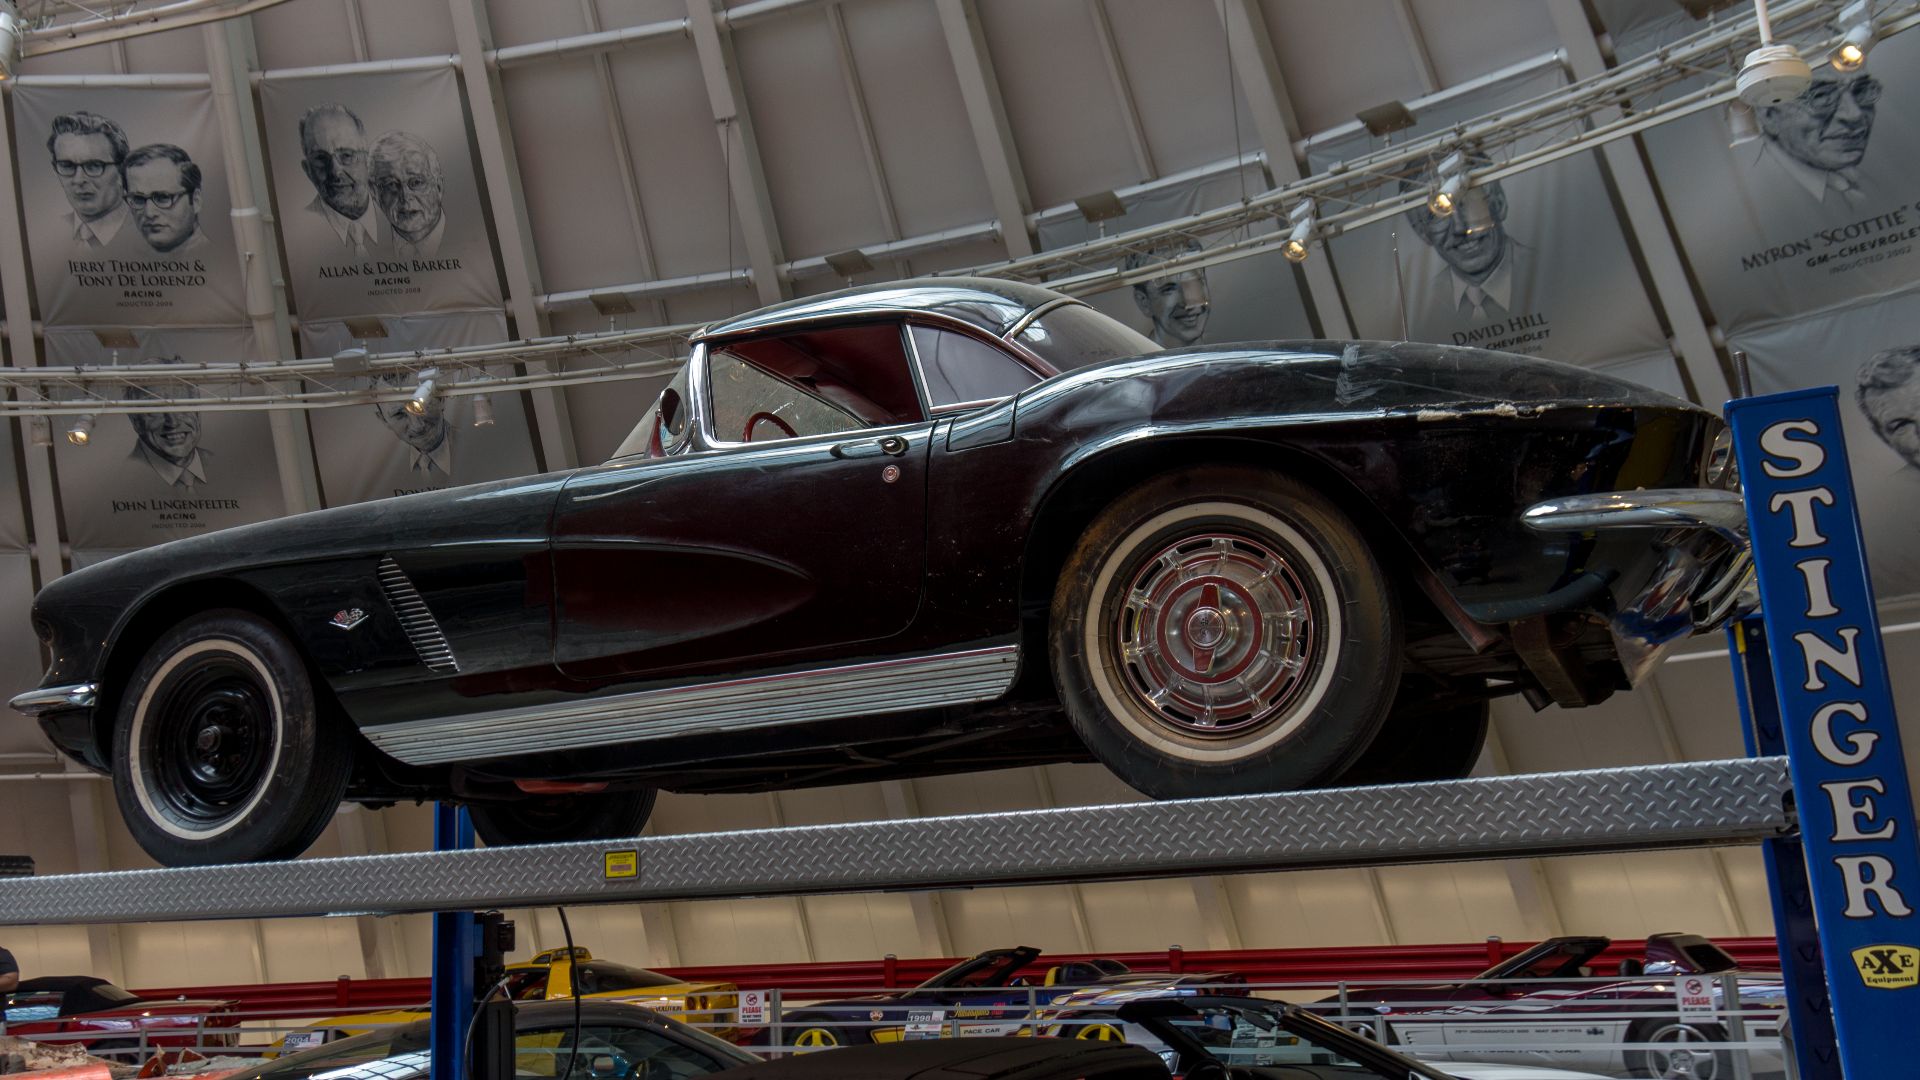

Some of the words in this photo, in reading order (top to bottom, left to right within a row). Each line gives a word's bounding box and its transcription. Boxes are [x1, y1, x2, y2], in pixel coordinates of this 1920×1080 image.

[1741, 238, 1813, 272] MYRON
[68, 259, 105, 274] JERRY
[108, 259, 190, 272] THOMPSON
[194, 259, 206, 272] &
[319, 264, 359, 279] ALLAN
[362, 262, 375, 275] &
[377, 261, 409, 274] DON
[412, 258, 462, 272] BARKER
[75, 274, 114, 287] TONY
[117, 274, 137, 287] DE
[141, 273, 206, 287] LORENZO
[374, 276, 411, 286] RACING
[123, 290, 163, 298] RACING
[1452, 323, 1505, 346] DAVID
[1507, 312, 1549, 332] HILL
[112, 500, 148, 513] JOHN
[151, 499, 240, 511] LINGENFELTER
[159, 512, 197, 520] RACING
[1759, 418, 1914, 919] STINGER
[1861, 949, 1914, 975] AXE
[1866, 976, 1914, 984] Equipment
[1682, 996, 1712, 1005] PLEASE
